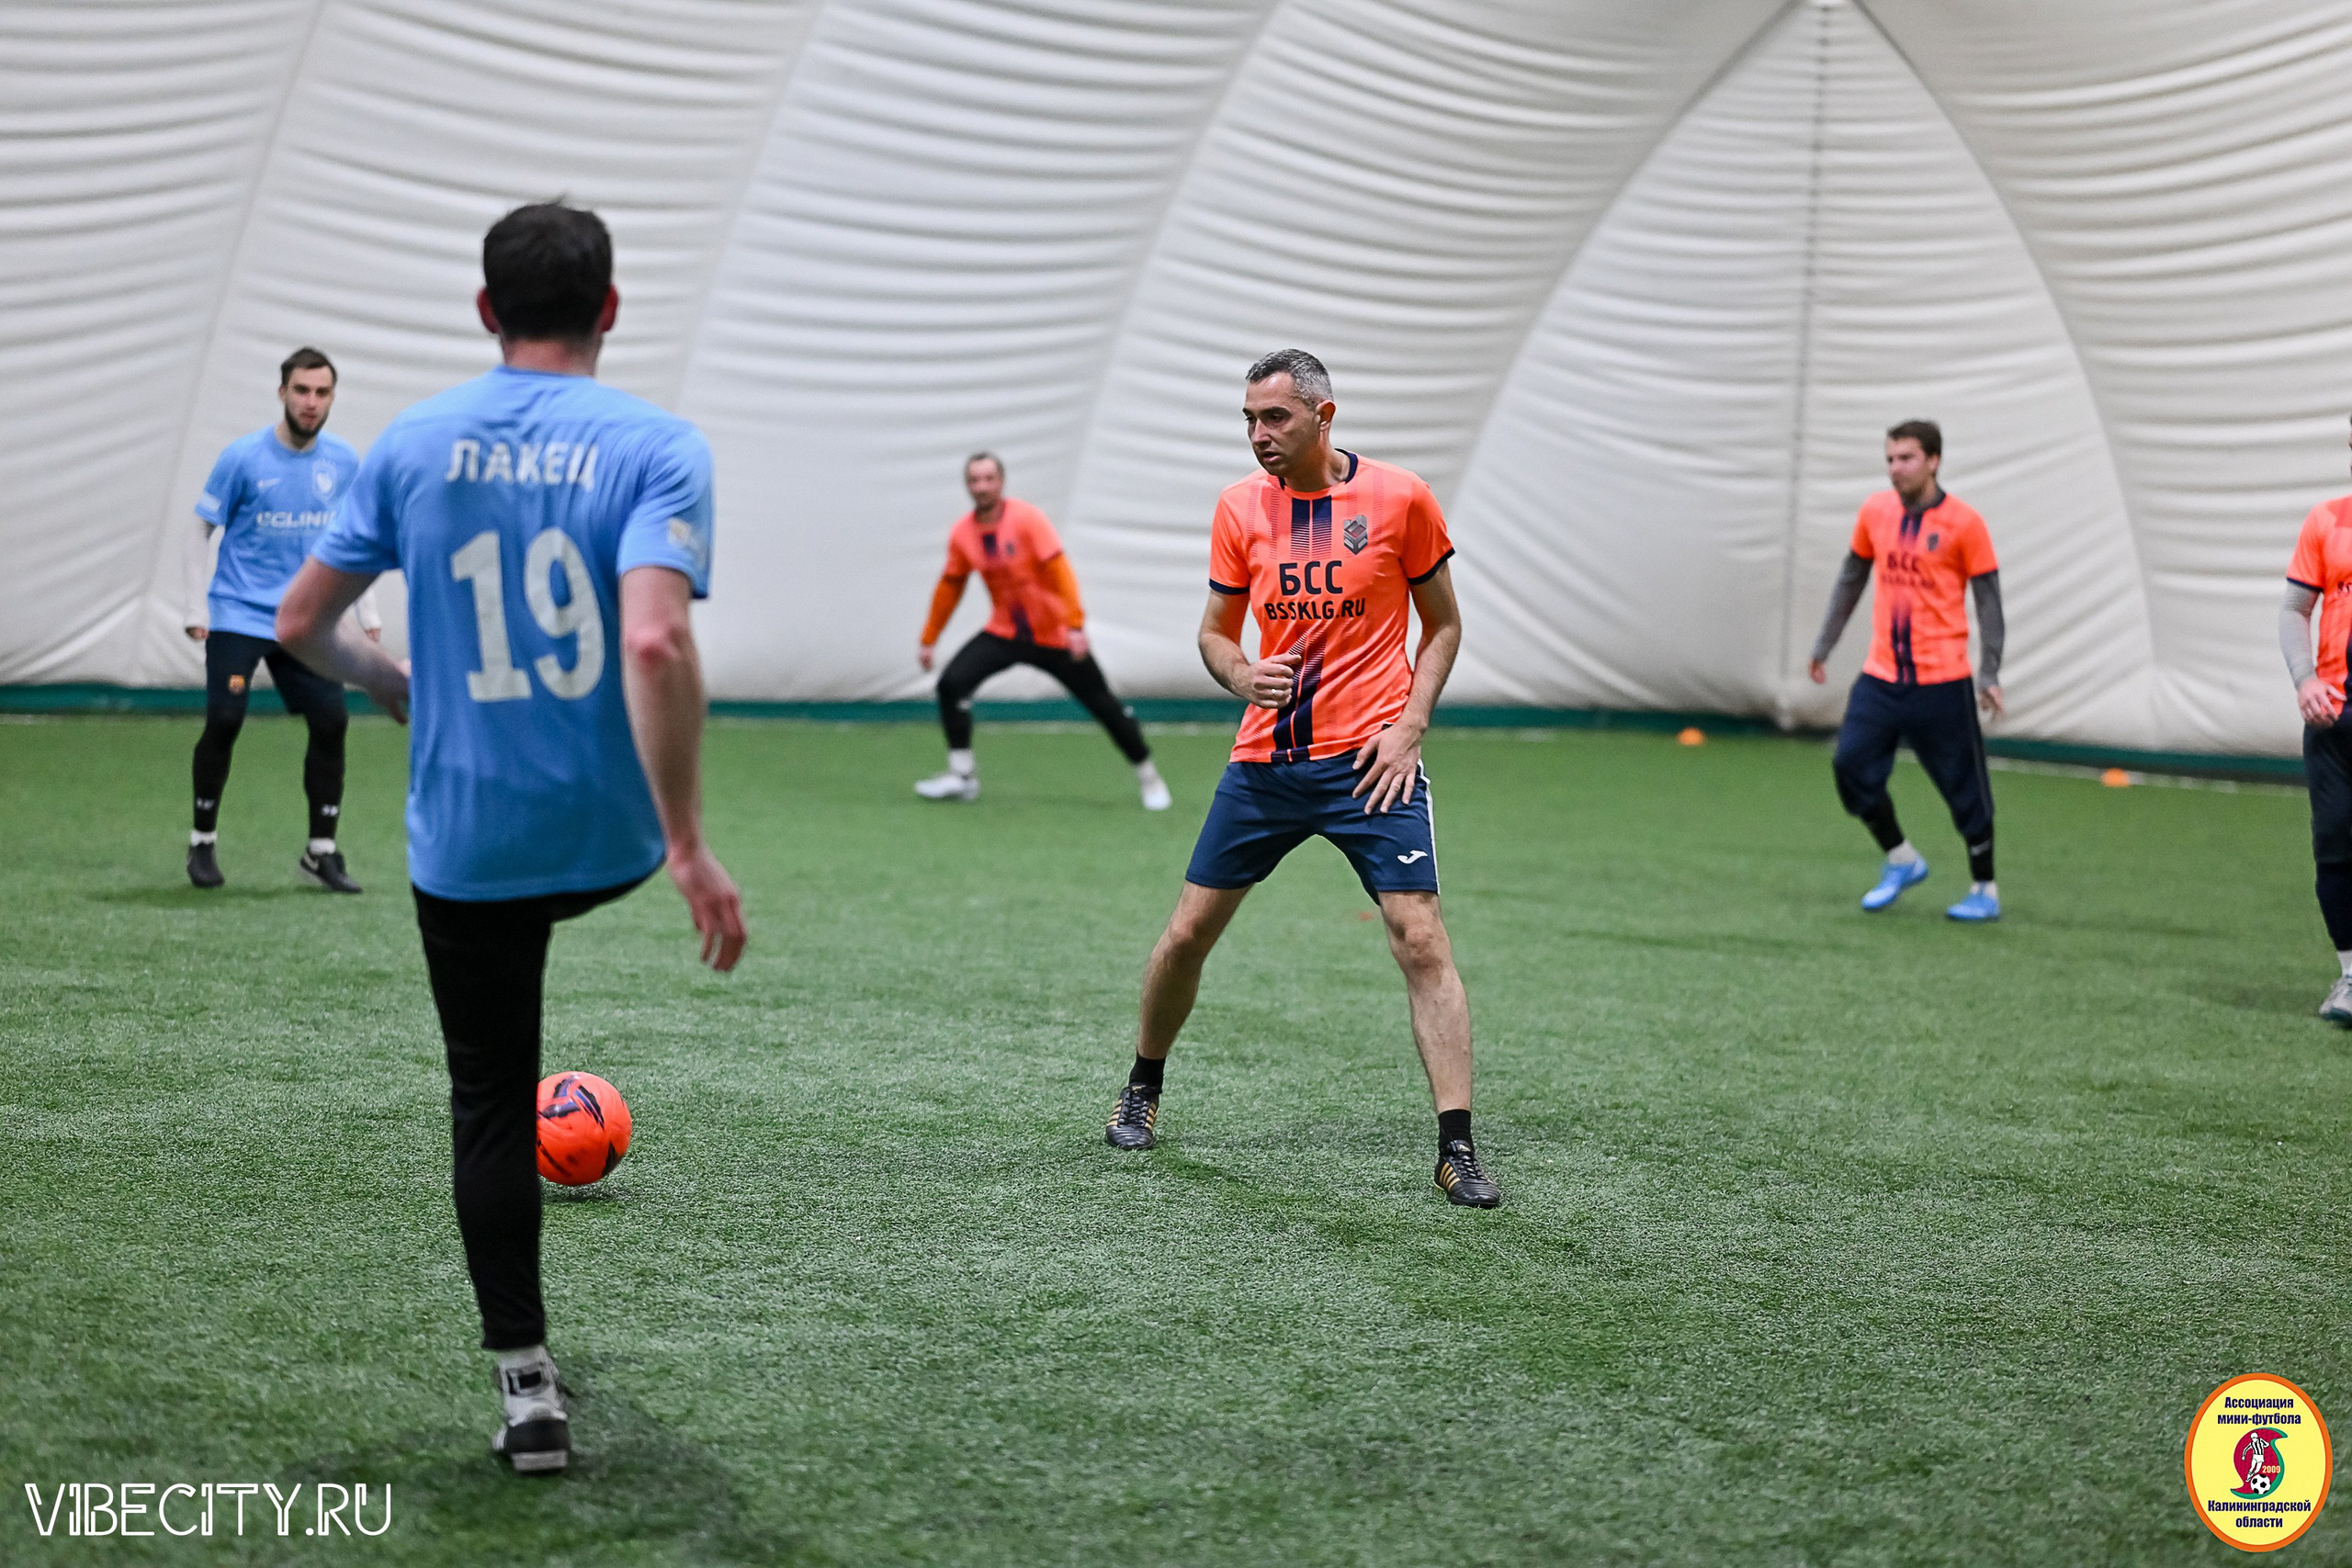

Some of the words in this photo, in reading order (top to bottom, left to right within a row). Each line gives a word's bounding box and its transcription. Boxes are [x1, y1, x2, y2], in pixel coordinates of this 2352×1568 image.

[446, 438, 600, 492] ЛАКЕЦ
[1279, 559, 1343, 596] БСС
[450, 525, 606, 704] 19
[1263, 597, 1366, 621] BSSKLG.RU
